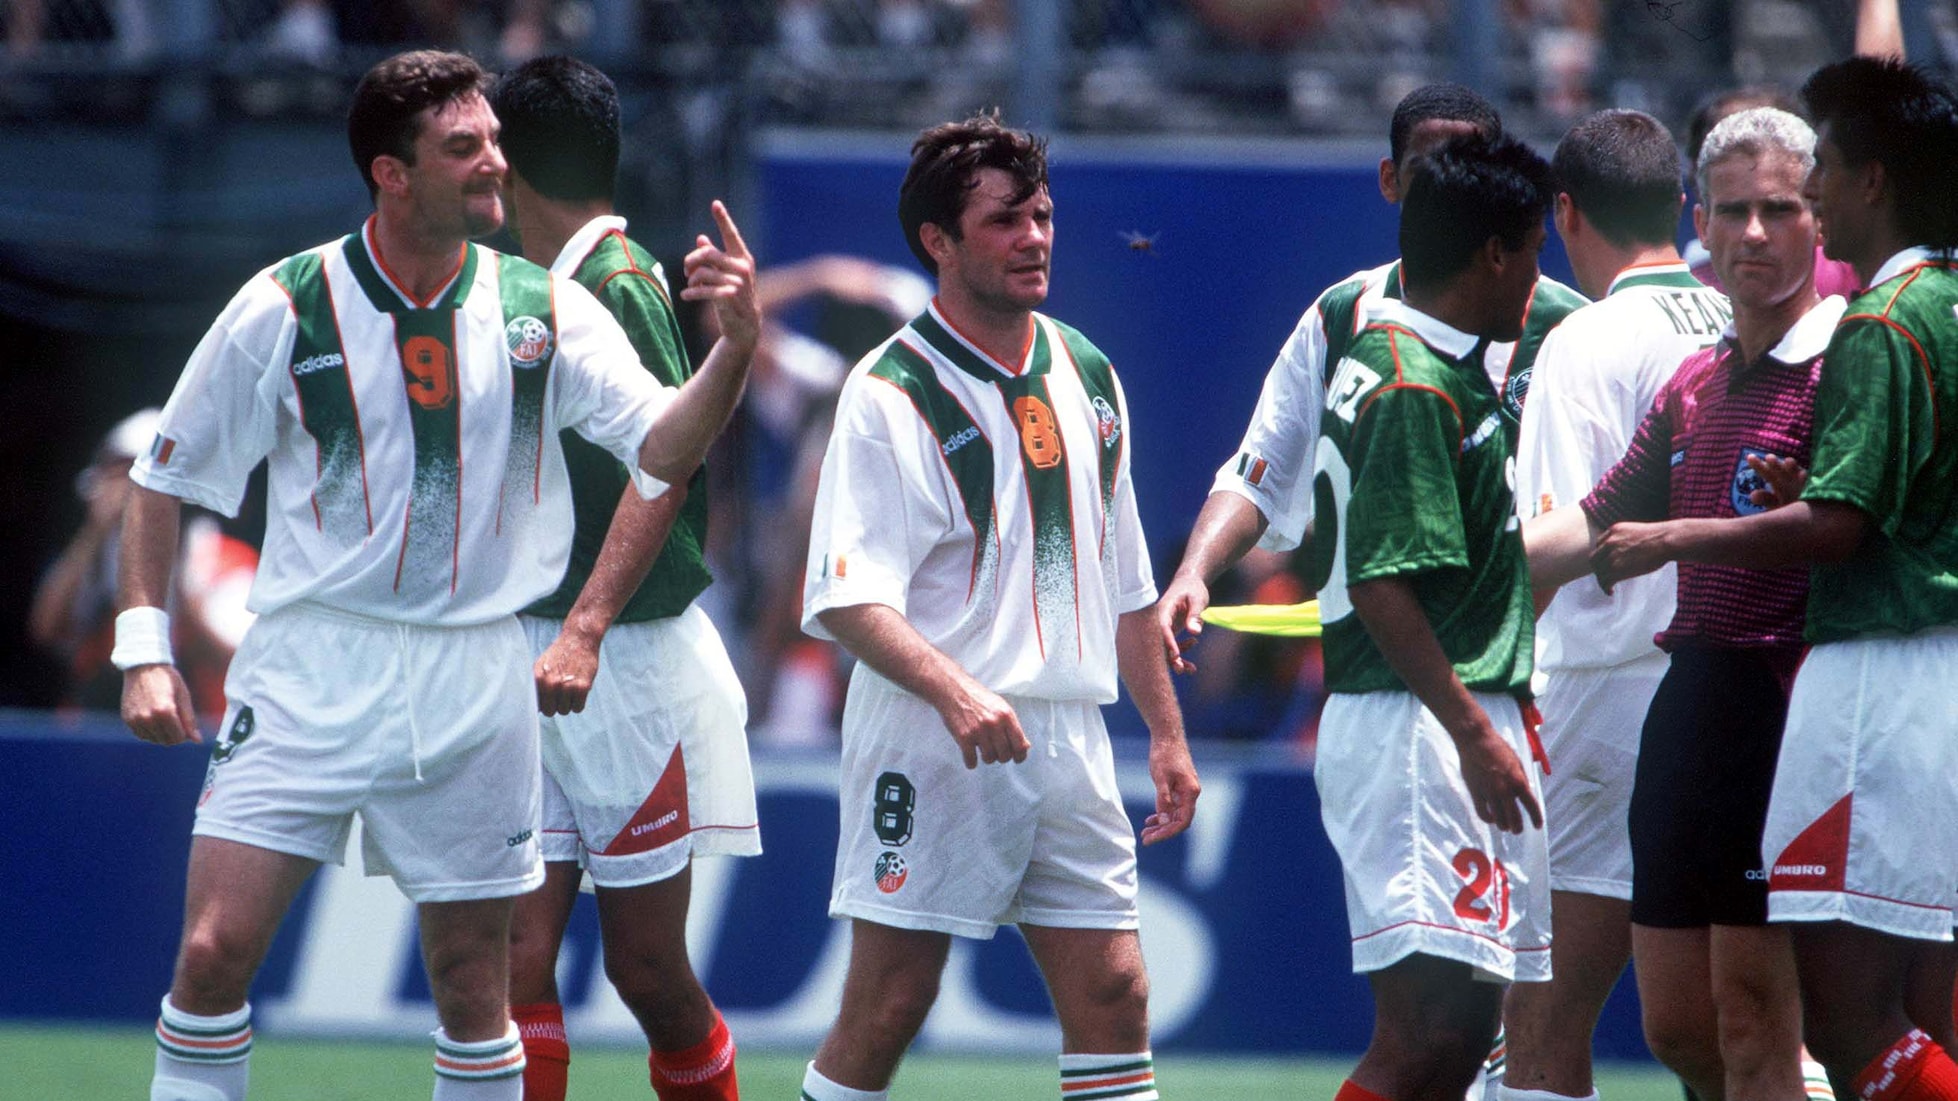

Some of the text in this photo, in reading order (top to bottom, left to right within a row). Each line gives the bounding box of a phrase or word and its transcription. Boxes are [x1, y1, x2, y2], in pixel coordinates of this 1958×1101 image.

[1650, 292, 1734, 336] KEAN
[292, 352, 344, 376] adidas
[402, 335, 453, 410] 9
[1012, 396, 1062, 470] 8
[874, 771, 915, 848] 8
[1773, 863, 1827, 876] UMBRO
